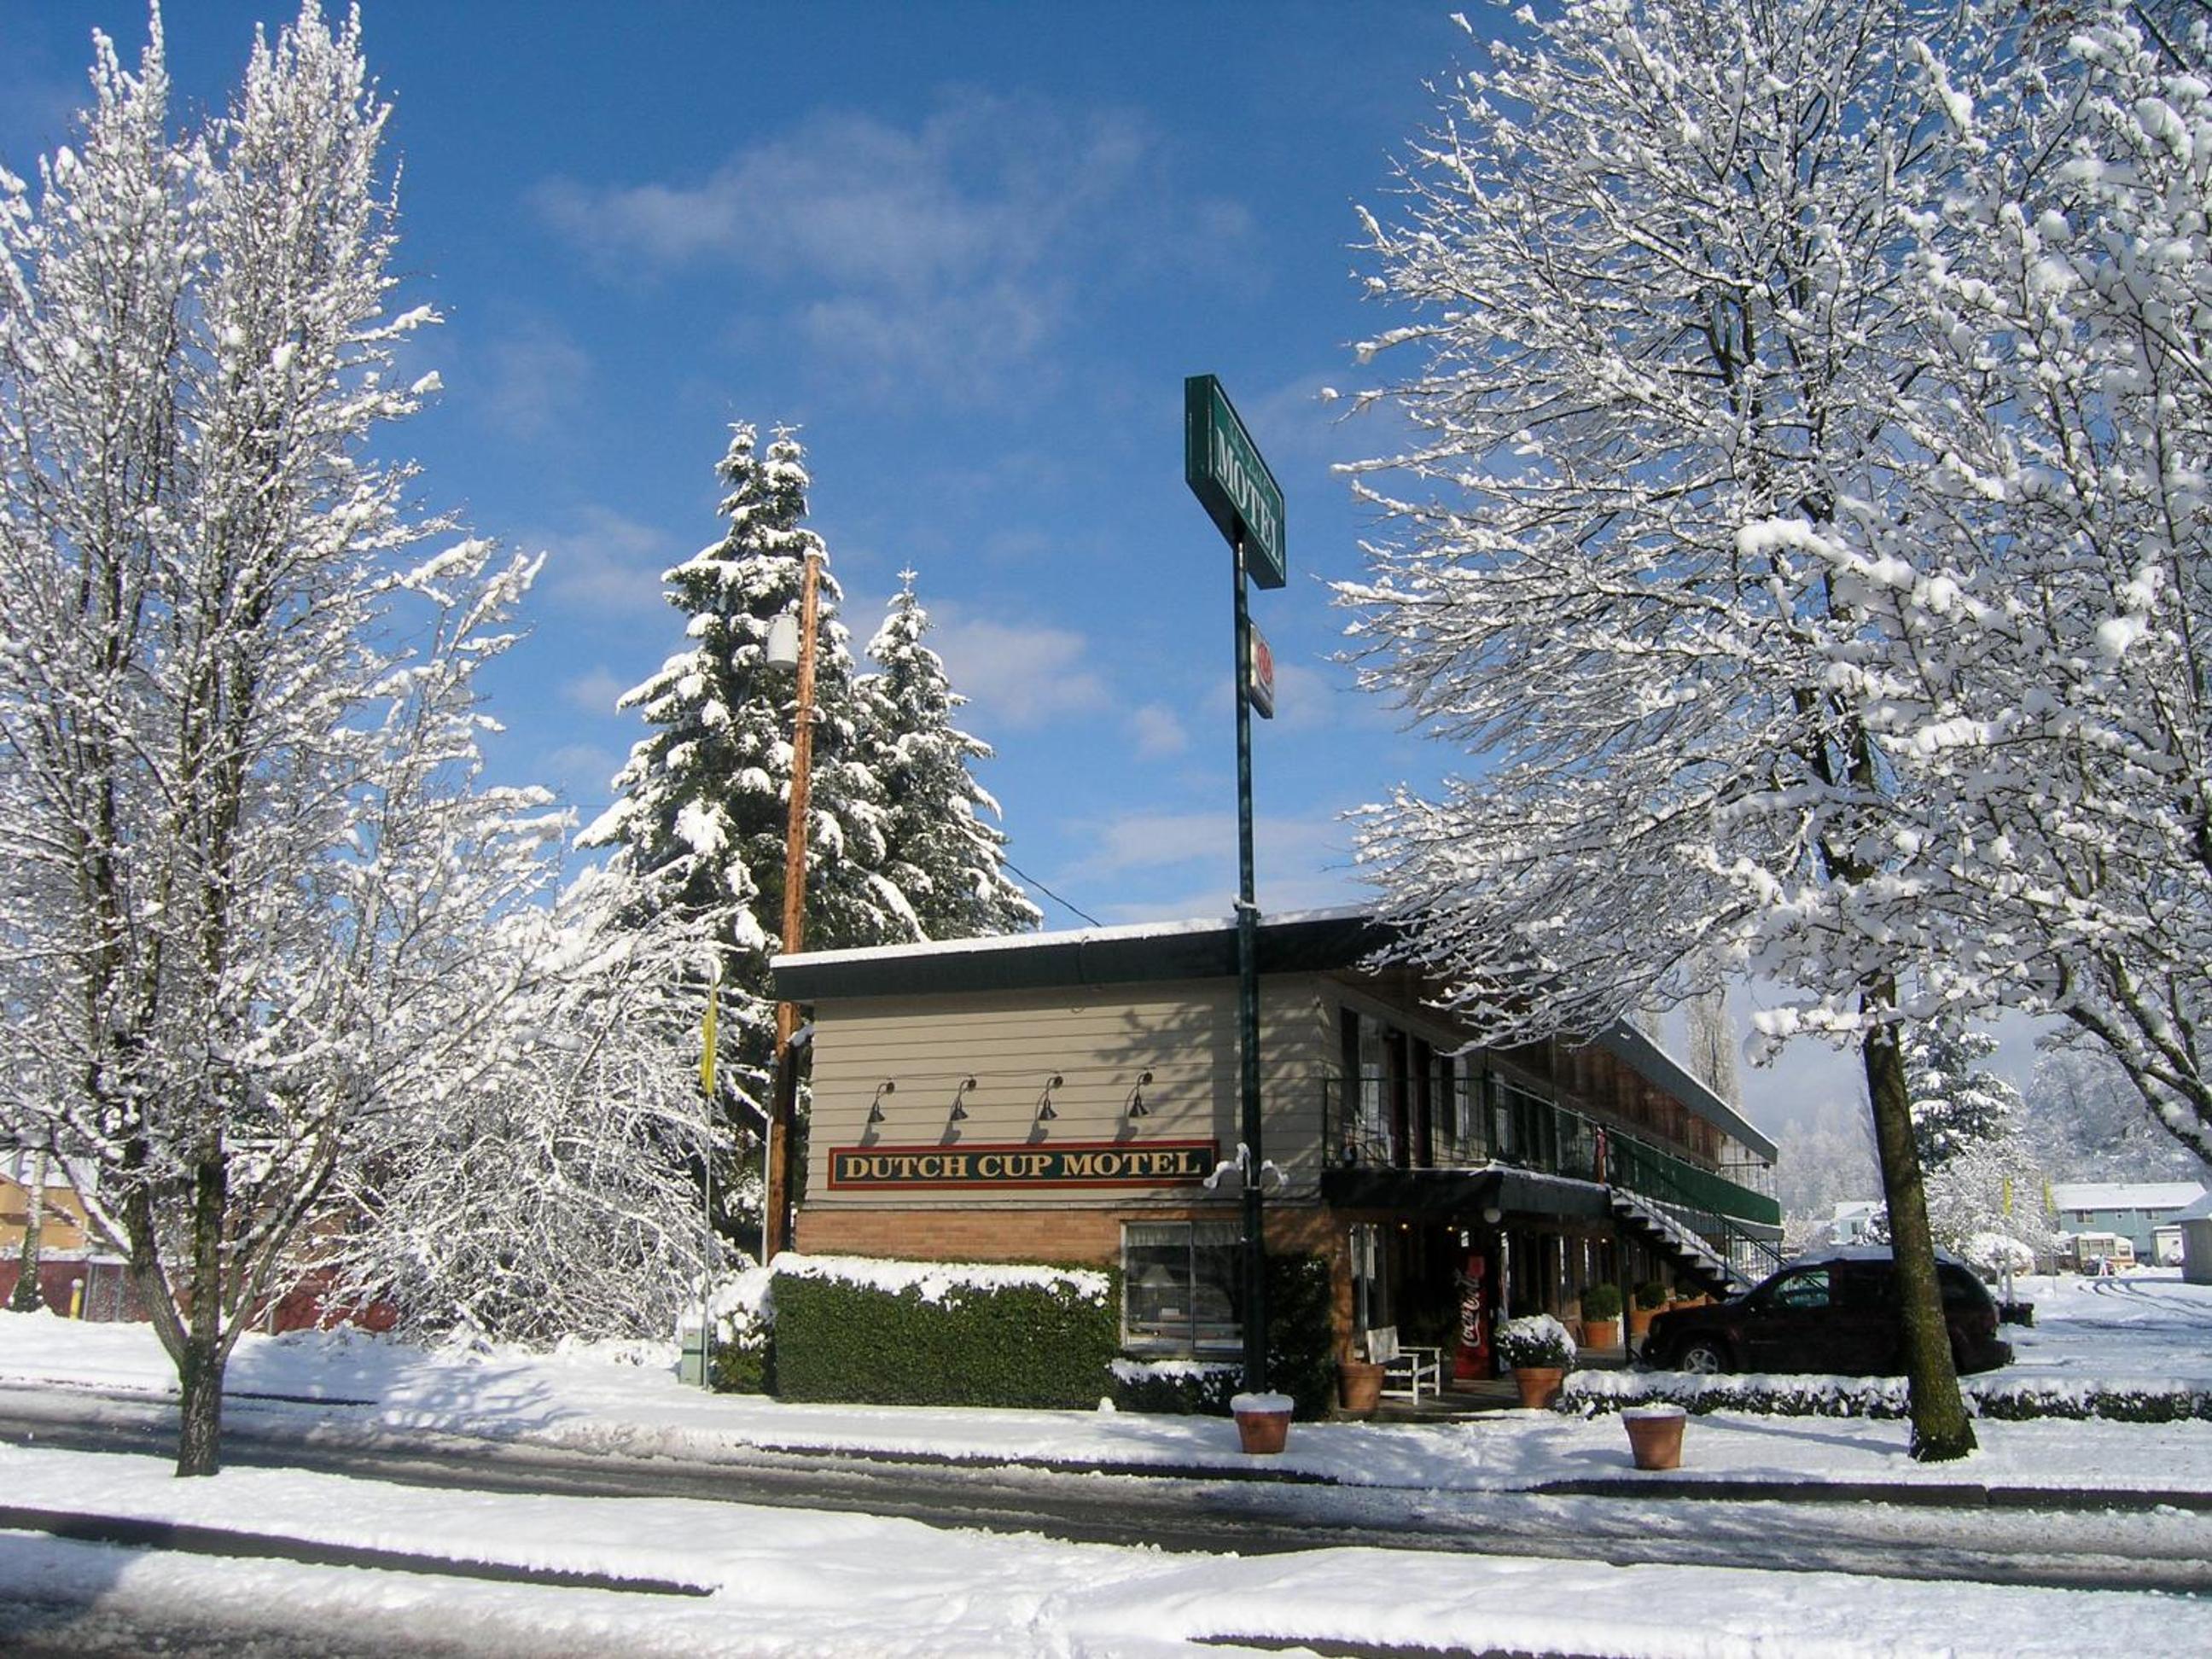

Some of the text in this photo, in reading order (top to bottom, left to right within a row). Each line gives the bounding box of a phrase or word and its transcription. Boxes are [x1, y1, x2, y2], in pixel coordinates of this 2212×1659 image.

[1217, 426, 1282, 567] MOTEL
[844, 1151, 1202, 1179] DUTCH CUP MOTEL
